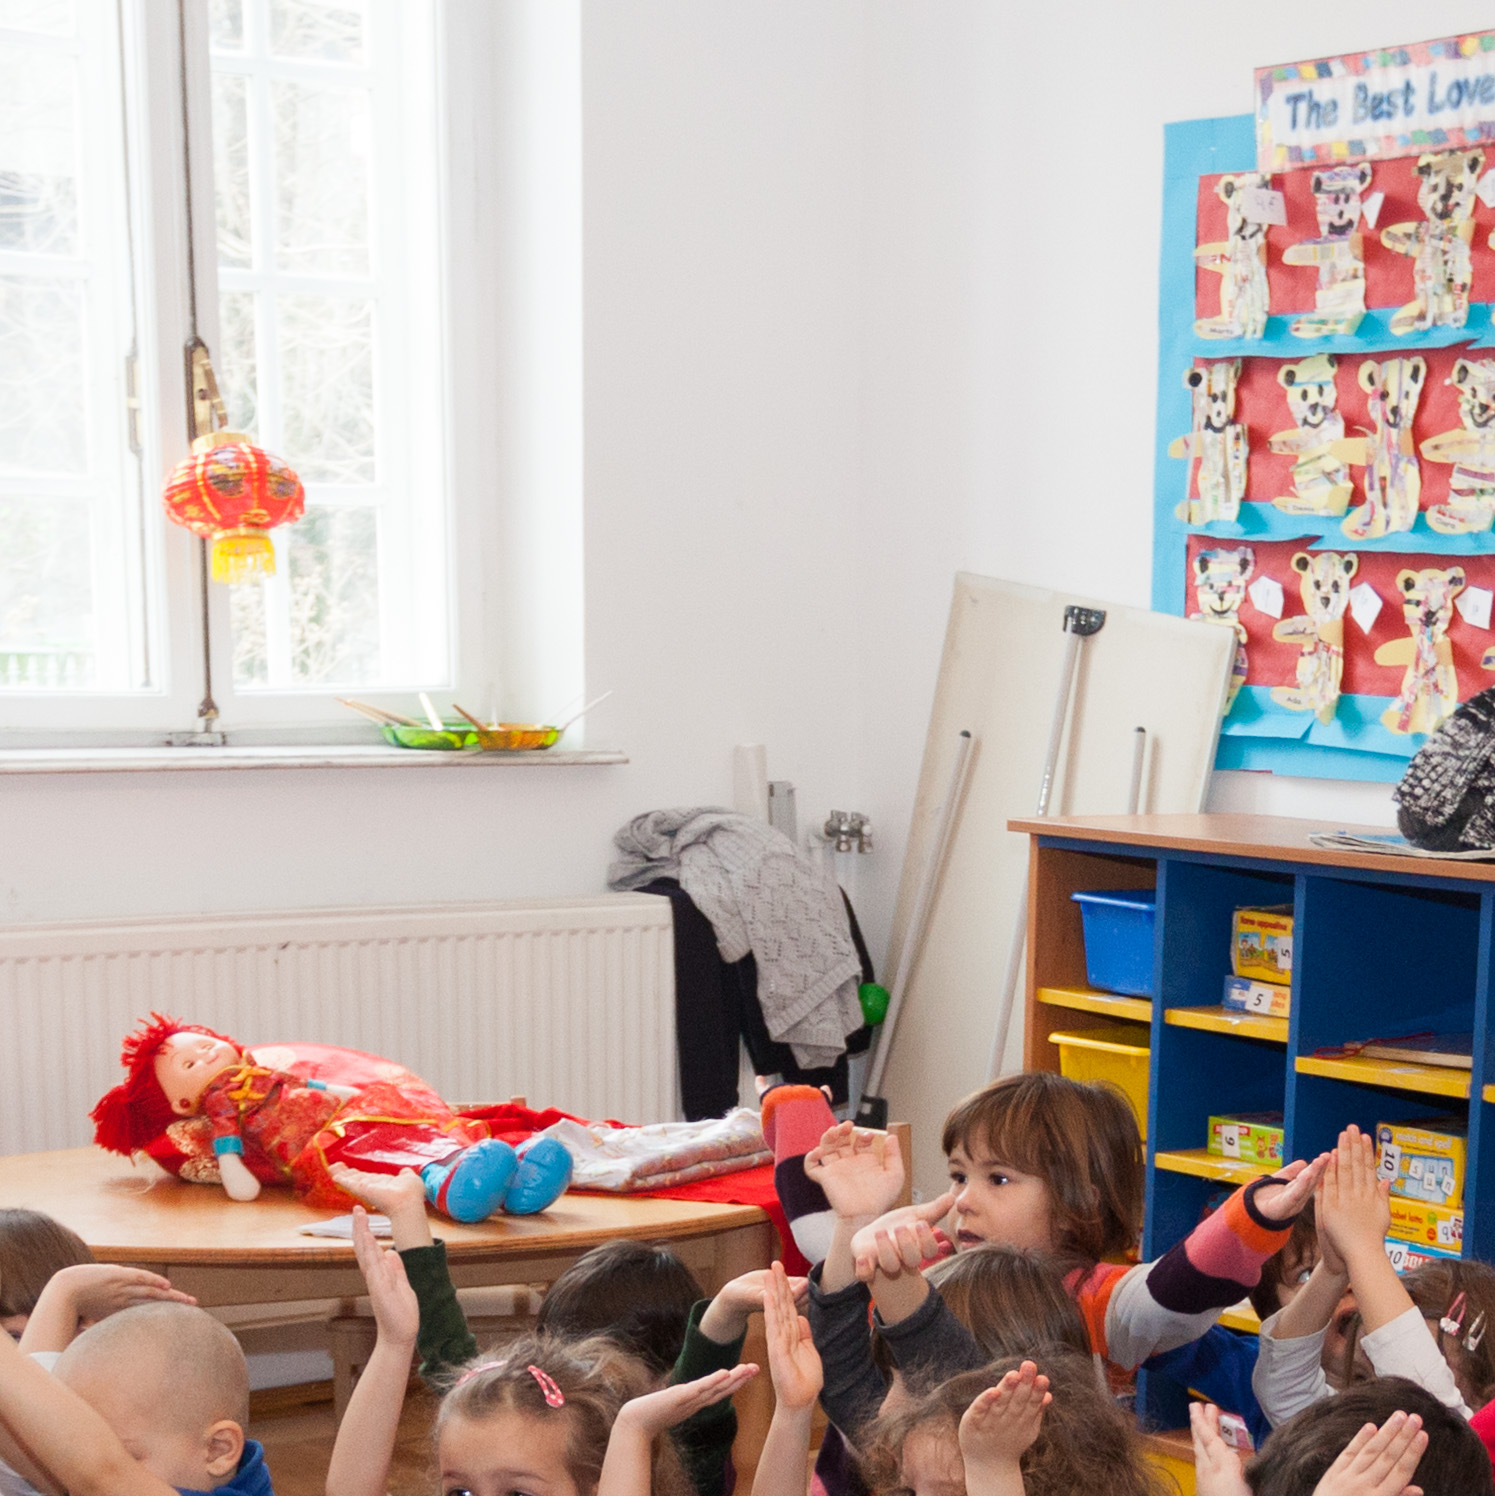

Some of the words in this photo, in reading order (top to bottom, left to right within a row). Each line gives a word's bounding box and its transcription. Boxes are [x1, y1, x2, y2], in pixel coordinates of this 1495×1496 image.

[1286, 90, 1339, 130] The
[1351, 78, 1415, 125] Best
[1281, 948, 1291, 959] 5
[1253, 993, 1264, 1007] 5
[1384, 1149, 1396, 1171] 10
[1388, 1251, 1403, 1265] 10
